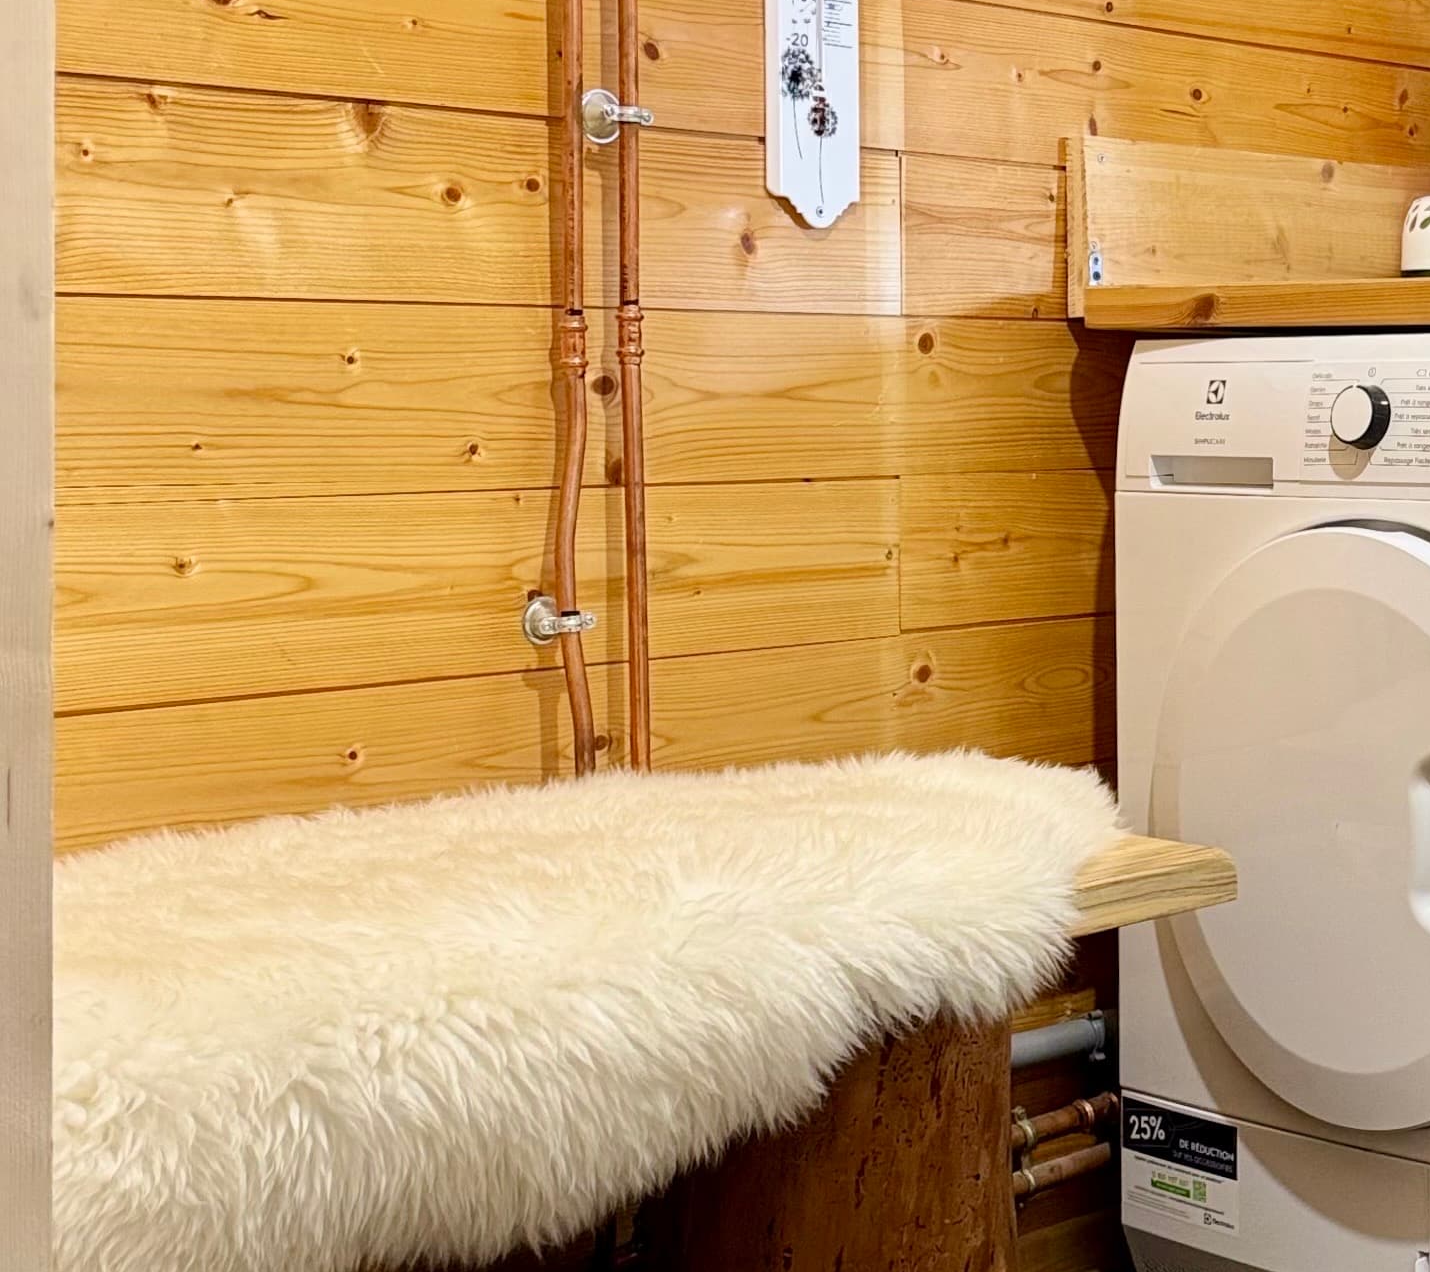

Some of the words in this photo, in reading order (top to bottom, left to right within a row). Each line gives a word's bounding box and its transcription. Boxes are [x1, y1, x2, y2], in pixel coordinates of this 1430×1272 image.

[1195, 410, 1230, 420] Electrolux
[1129, 1115, 1166, 1141] 25%
[1179, 1139, 1190, 1149] DE
[1191, 1141, 1235, 1161] RÉDUCTION
